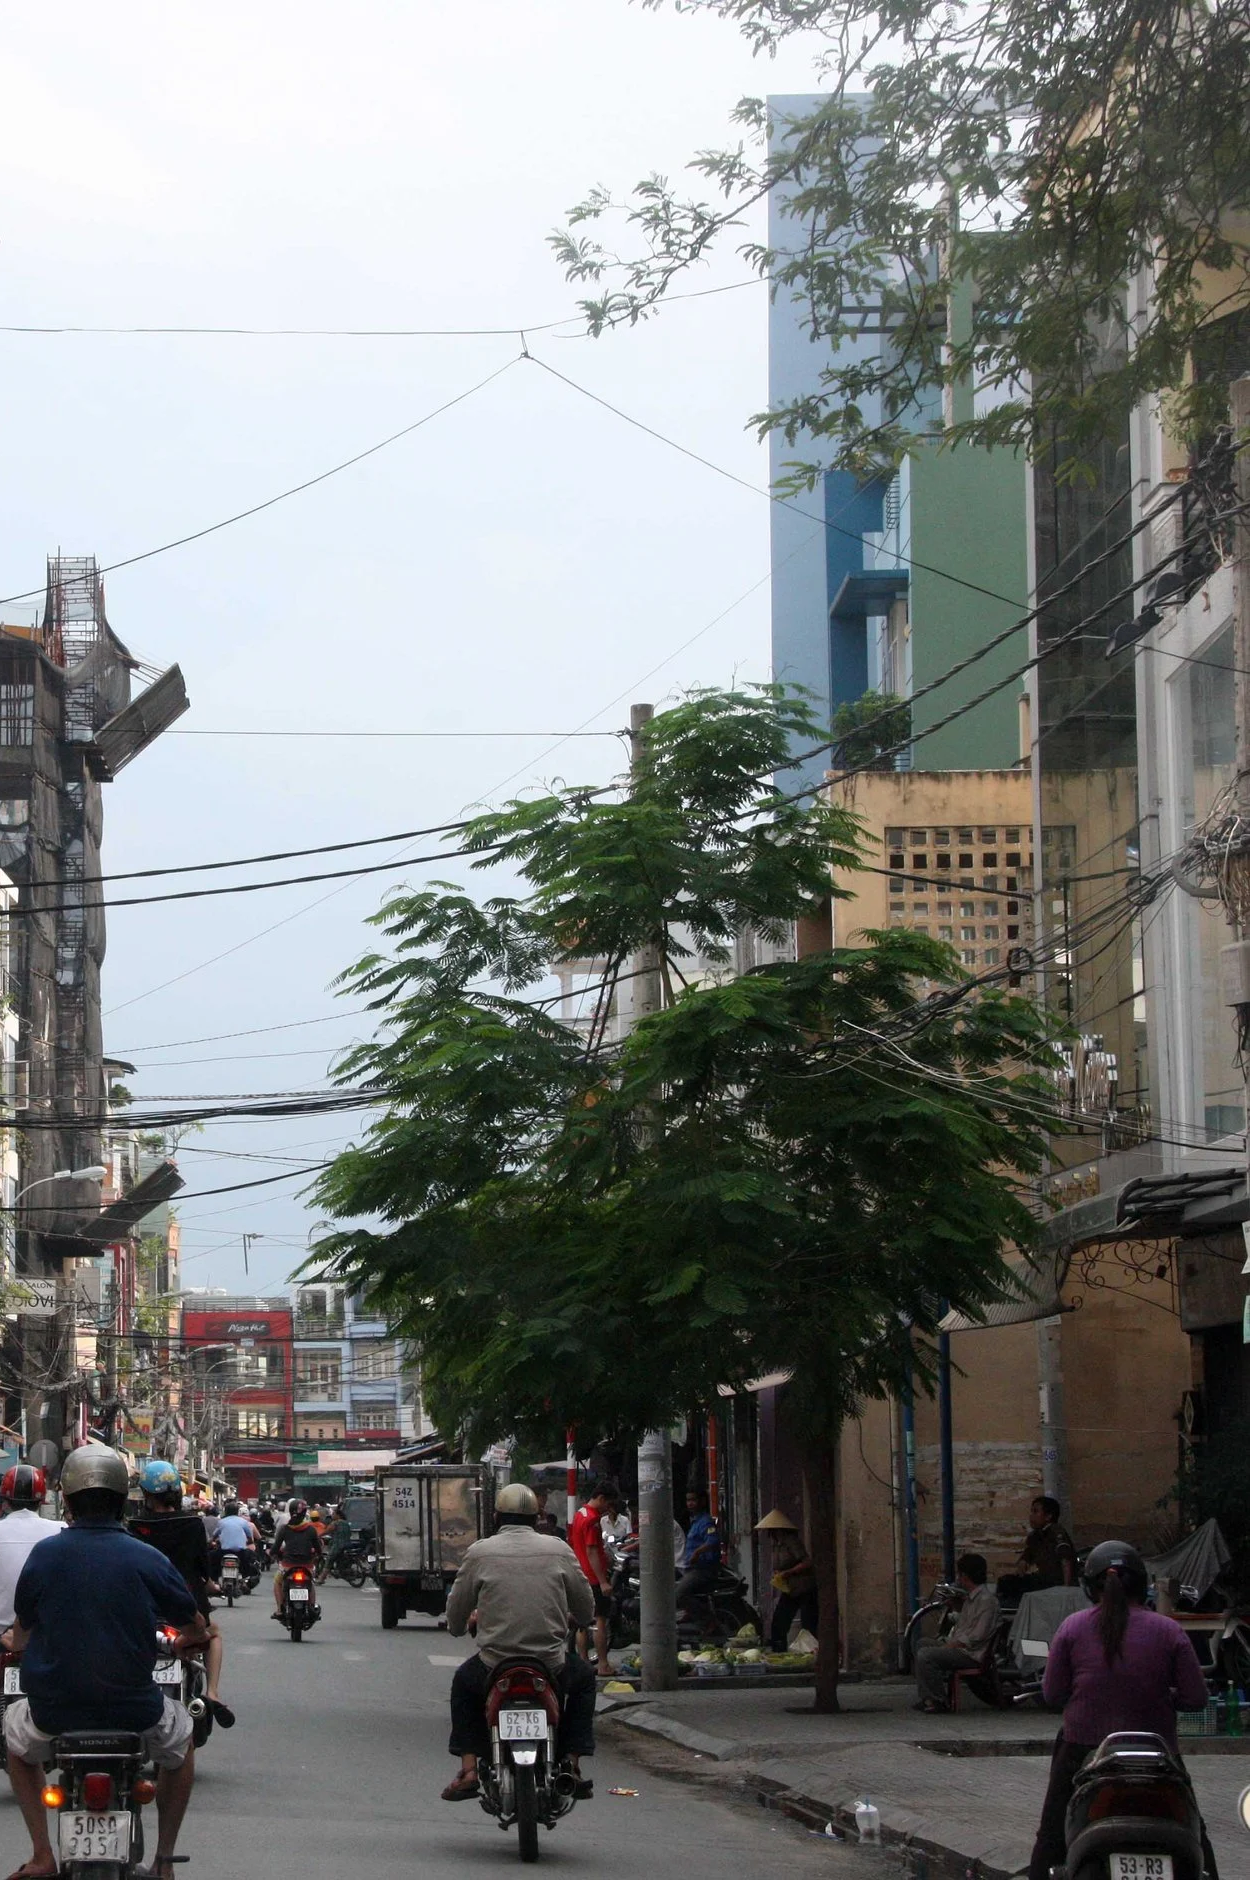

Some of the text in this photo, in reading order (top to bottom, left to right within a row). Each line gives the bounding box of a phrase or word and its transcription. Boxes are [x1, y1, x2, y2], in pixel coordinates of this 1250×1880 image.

[395, 1487, 412, 1496] 54Z
[392, 1499, 415, 1509] 4514
[507, 1725, 540, 1738] 7642
[1119, 1857, 1164, 1875] 53-R3
